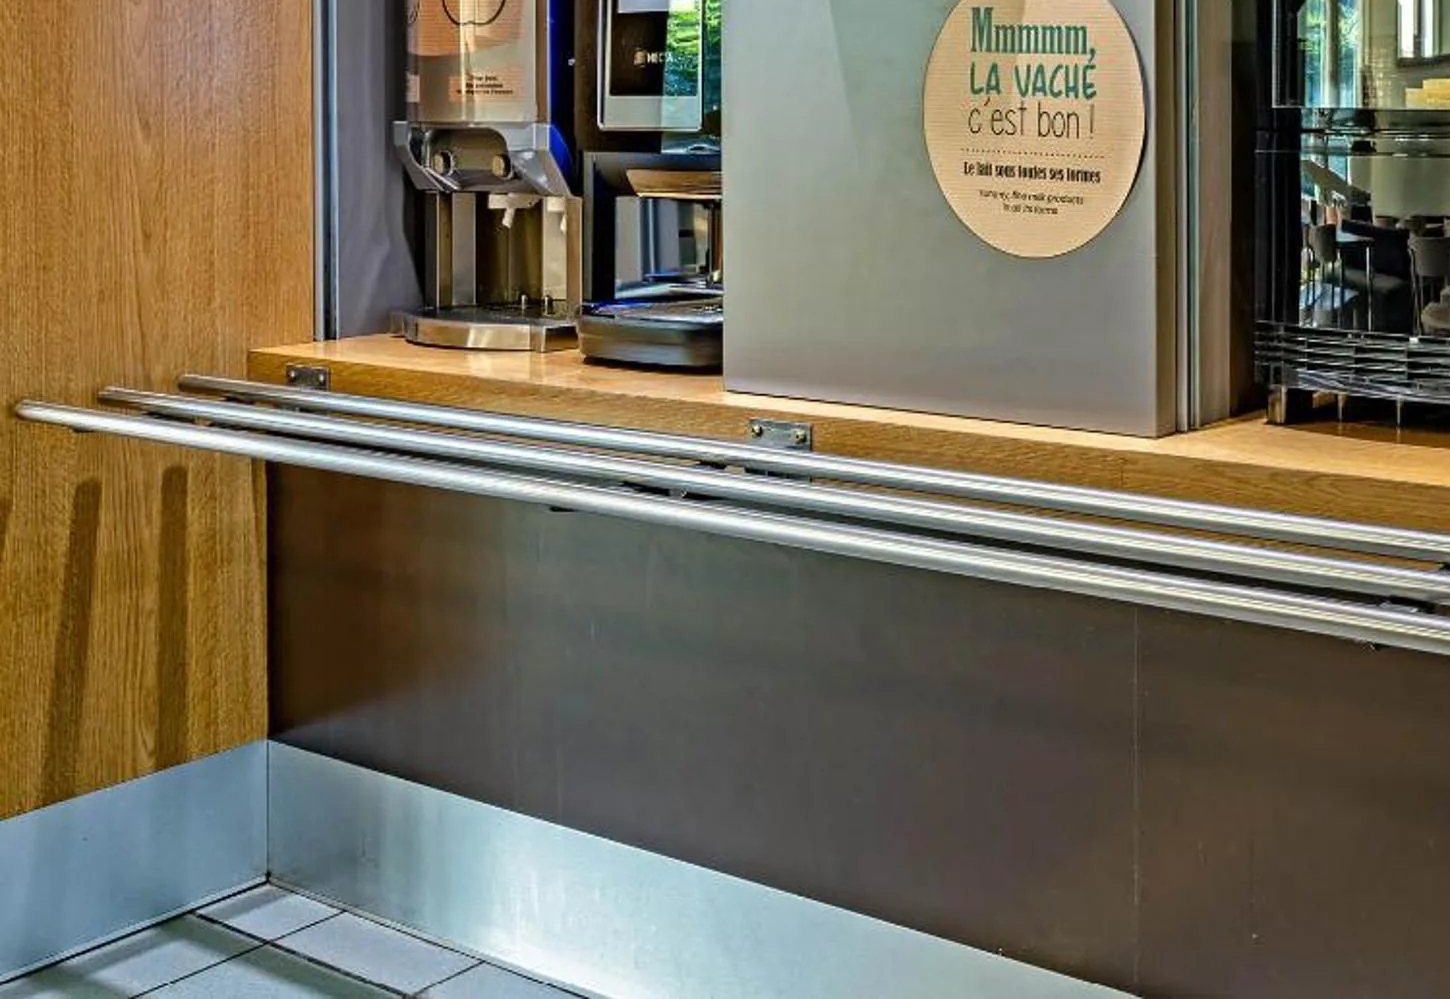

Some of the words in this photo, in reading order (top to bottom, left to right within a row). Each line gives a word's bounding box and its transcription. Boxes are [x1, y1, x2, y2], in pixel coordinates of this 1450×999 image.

[969, 62, 1001, 96] LA
[1013, 62, 1097, 100] VACHE
[968, 98, 1027, 136] c'est
[1037, 101, 1081, 140] bon
[1089, 104, 1095, 140] !
[963, 161, 975, 176] Le
